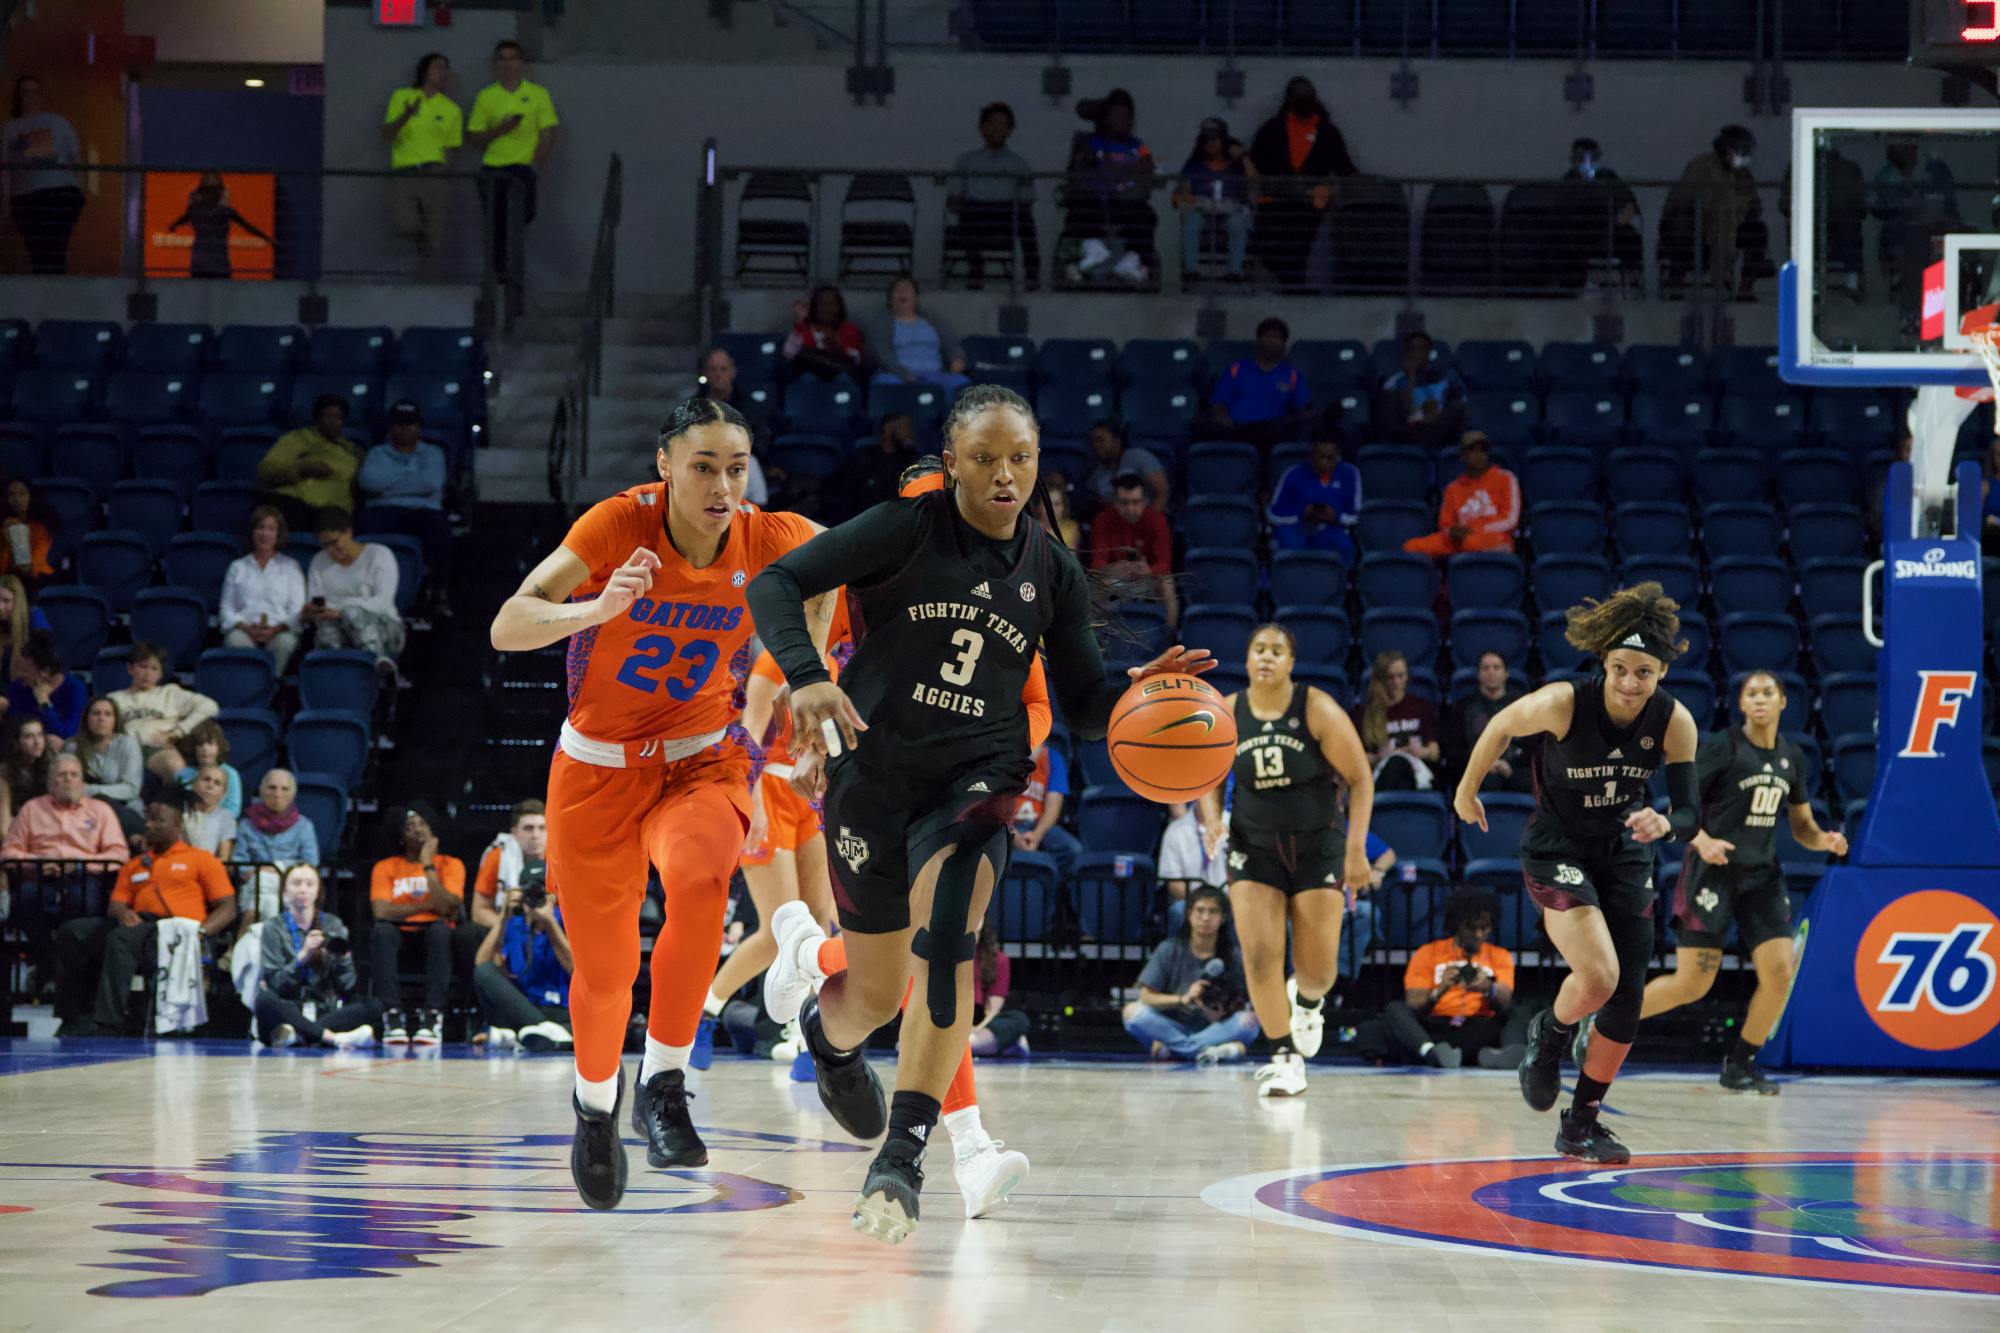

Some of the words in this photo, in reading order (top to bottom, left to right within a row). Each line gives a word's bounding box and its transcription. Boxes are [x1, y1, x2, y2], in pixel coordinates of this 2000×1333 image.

[1896, 560, 1976, 579] SPALDING
[970, 588, 992, 600] adidas
[1021, 583, 1035, 600] SEC
[629, 597, 744, 631] GATORS
[907, 602, 984, 622] FIGHTIN'
[985, 612, 1028, 654] TEXAS
[616, 634, 720, 703] 23
[940, 628, 985, 687] 3
[911, 682, 985, 718] AGGIES
[1142, 678, 1215, 697] ELITE
[1897, 670, 1977, 758] F
[1274, 734, 1305, 752] TEXAS
[1252, 745, 1285, 778] 13
[1566, 765, 1618, 779] FIGHTIN'
[1604, 780, 1617, 799] 1
[1751, 786, 1783, 815] 00
[1877, 923, 1997, 1015] 76
